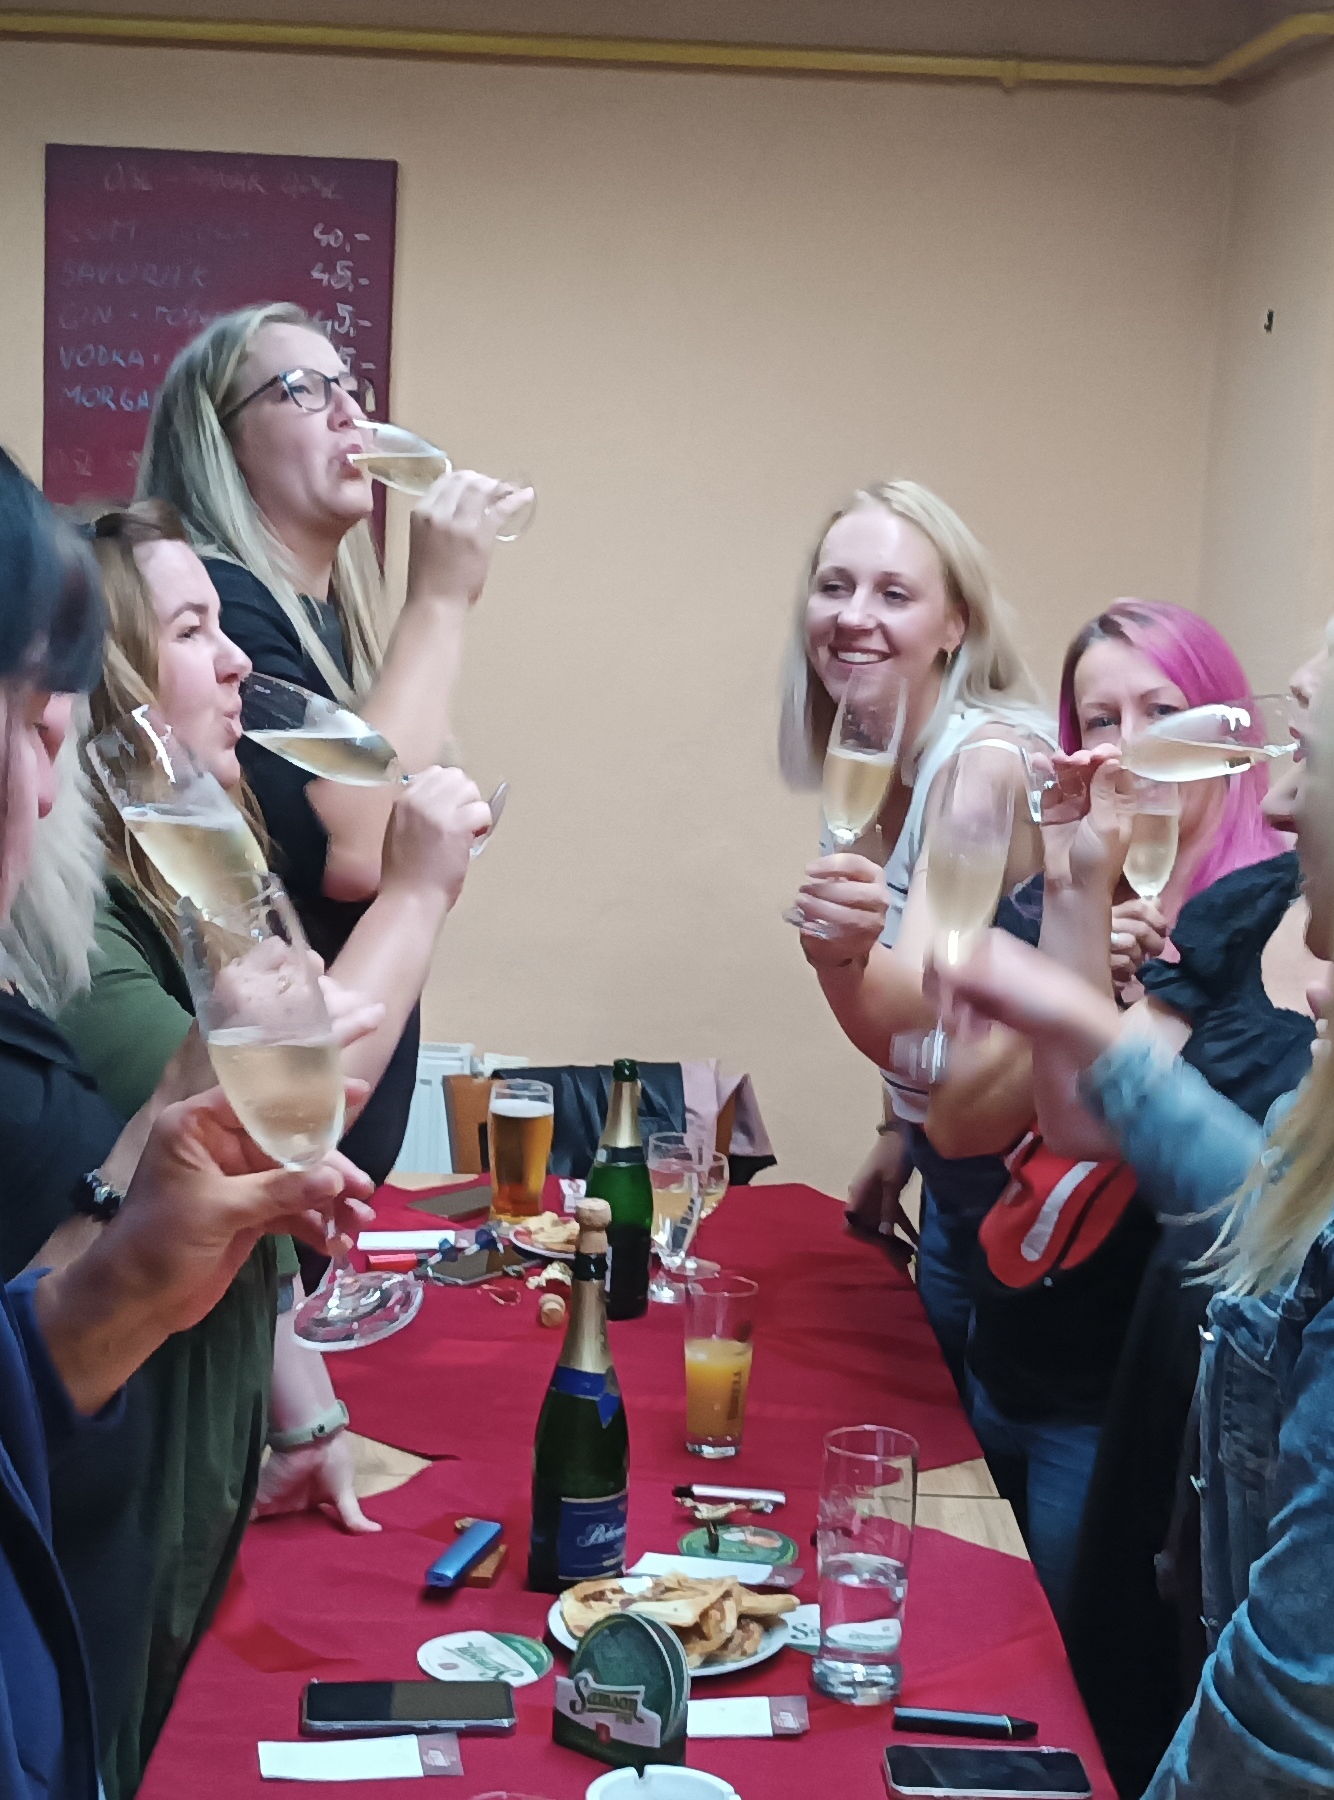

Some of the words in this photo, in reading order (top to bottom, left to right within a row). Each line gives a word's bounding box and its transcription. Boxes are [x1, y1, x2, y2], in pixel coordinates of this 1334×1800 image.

[312, 222, 372, 253] 40,-
[309, 260, 371, 293] 45,-
[58, 342, 146, 372] VODKA
[61, 384, 154, 412] MORGA
